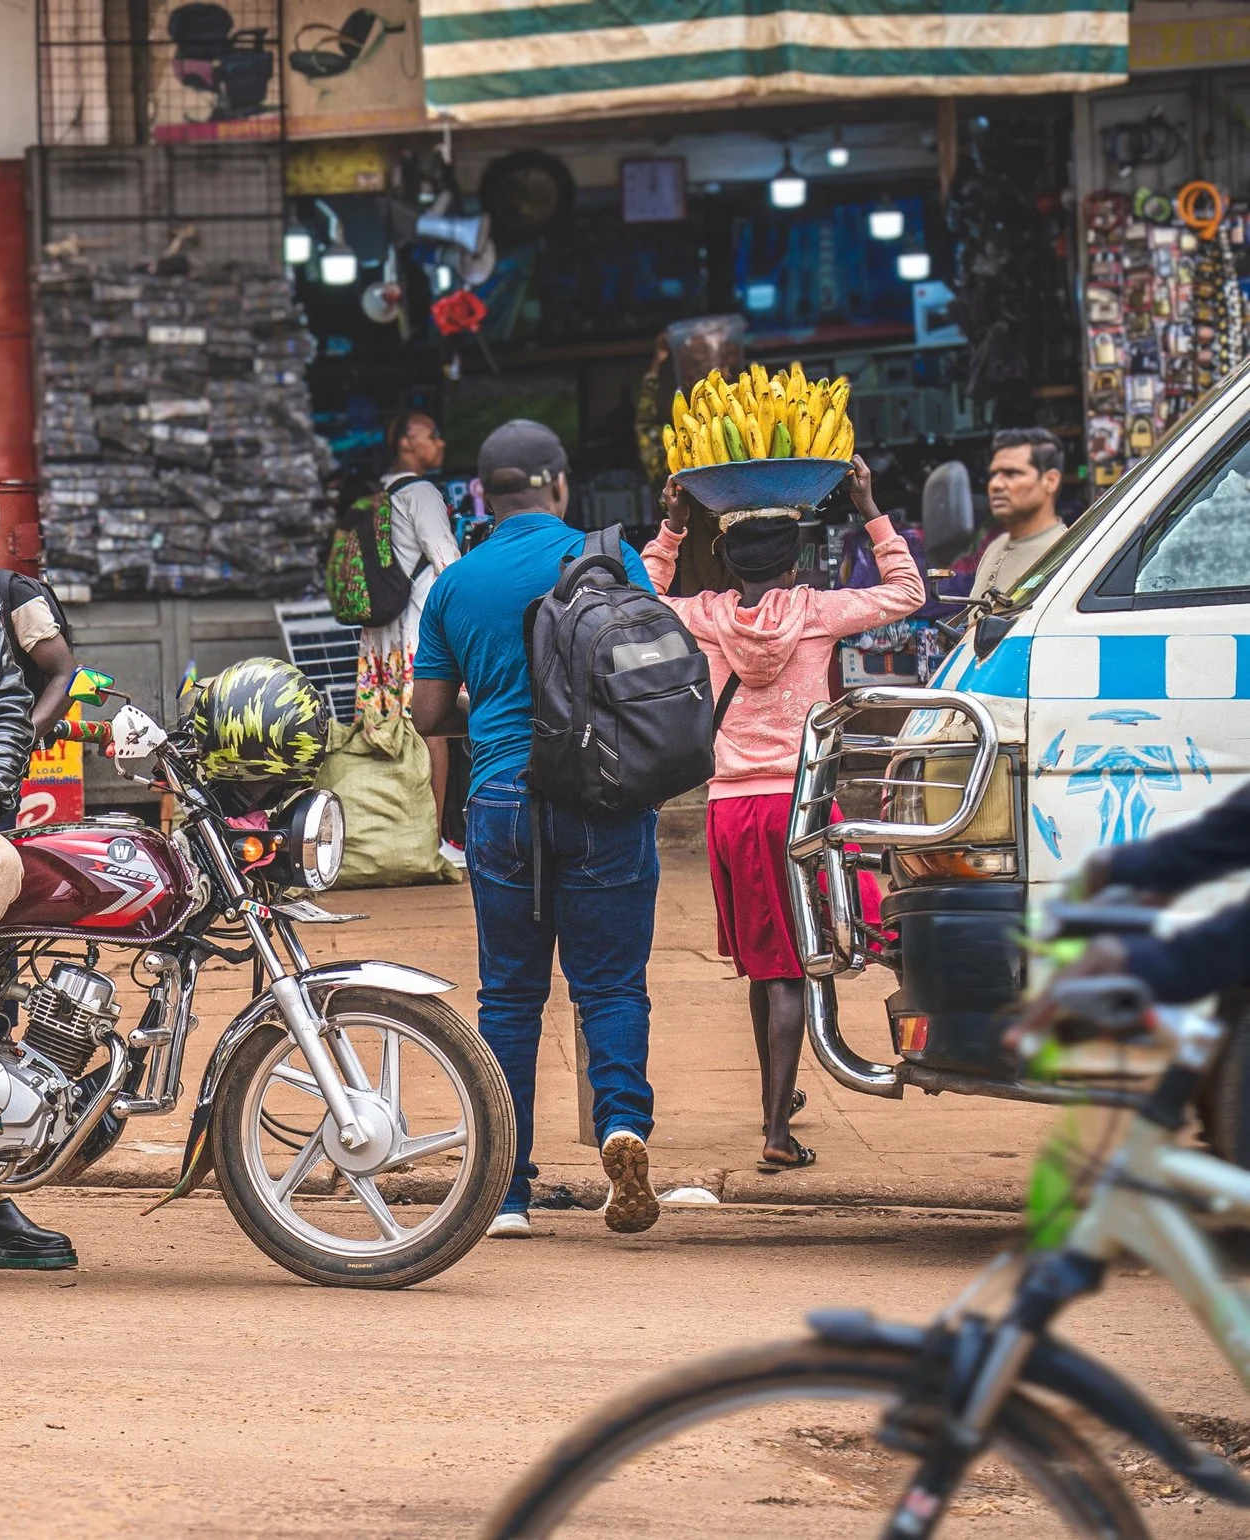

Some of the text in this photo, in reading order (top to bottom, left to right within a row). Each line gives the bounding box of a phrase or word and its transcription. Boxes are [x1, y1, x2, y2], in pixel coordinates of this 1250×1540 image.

[36, 767, 63, 775] LOAD
[30, 775, 81, 786] CHARGING
[88, 861, 159, 883] XPRESS
